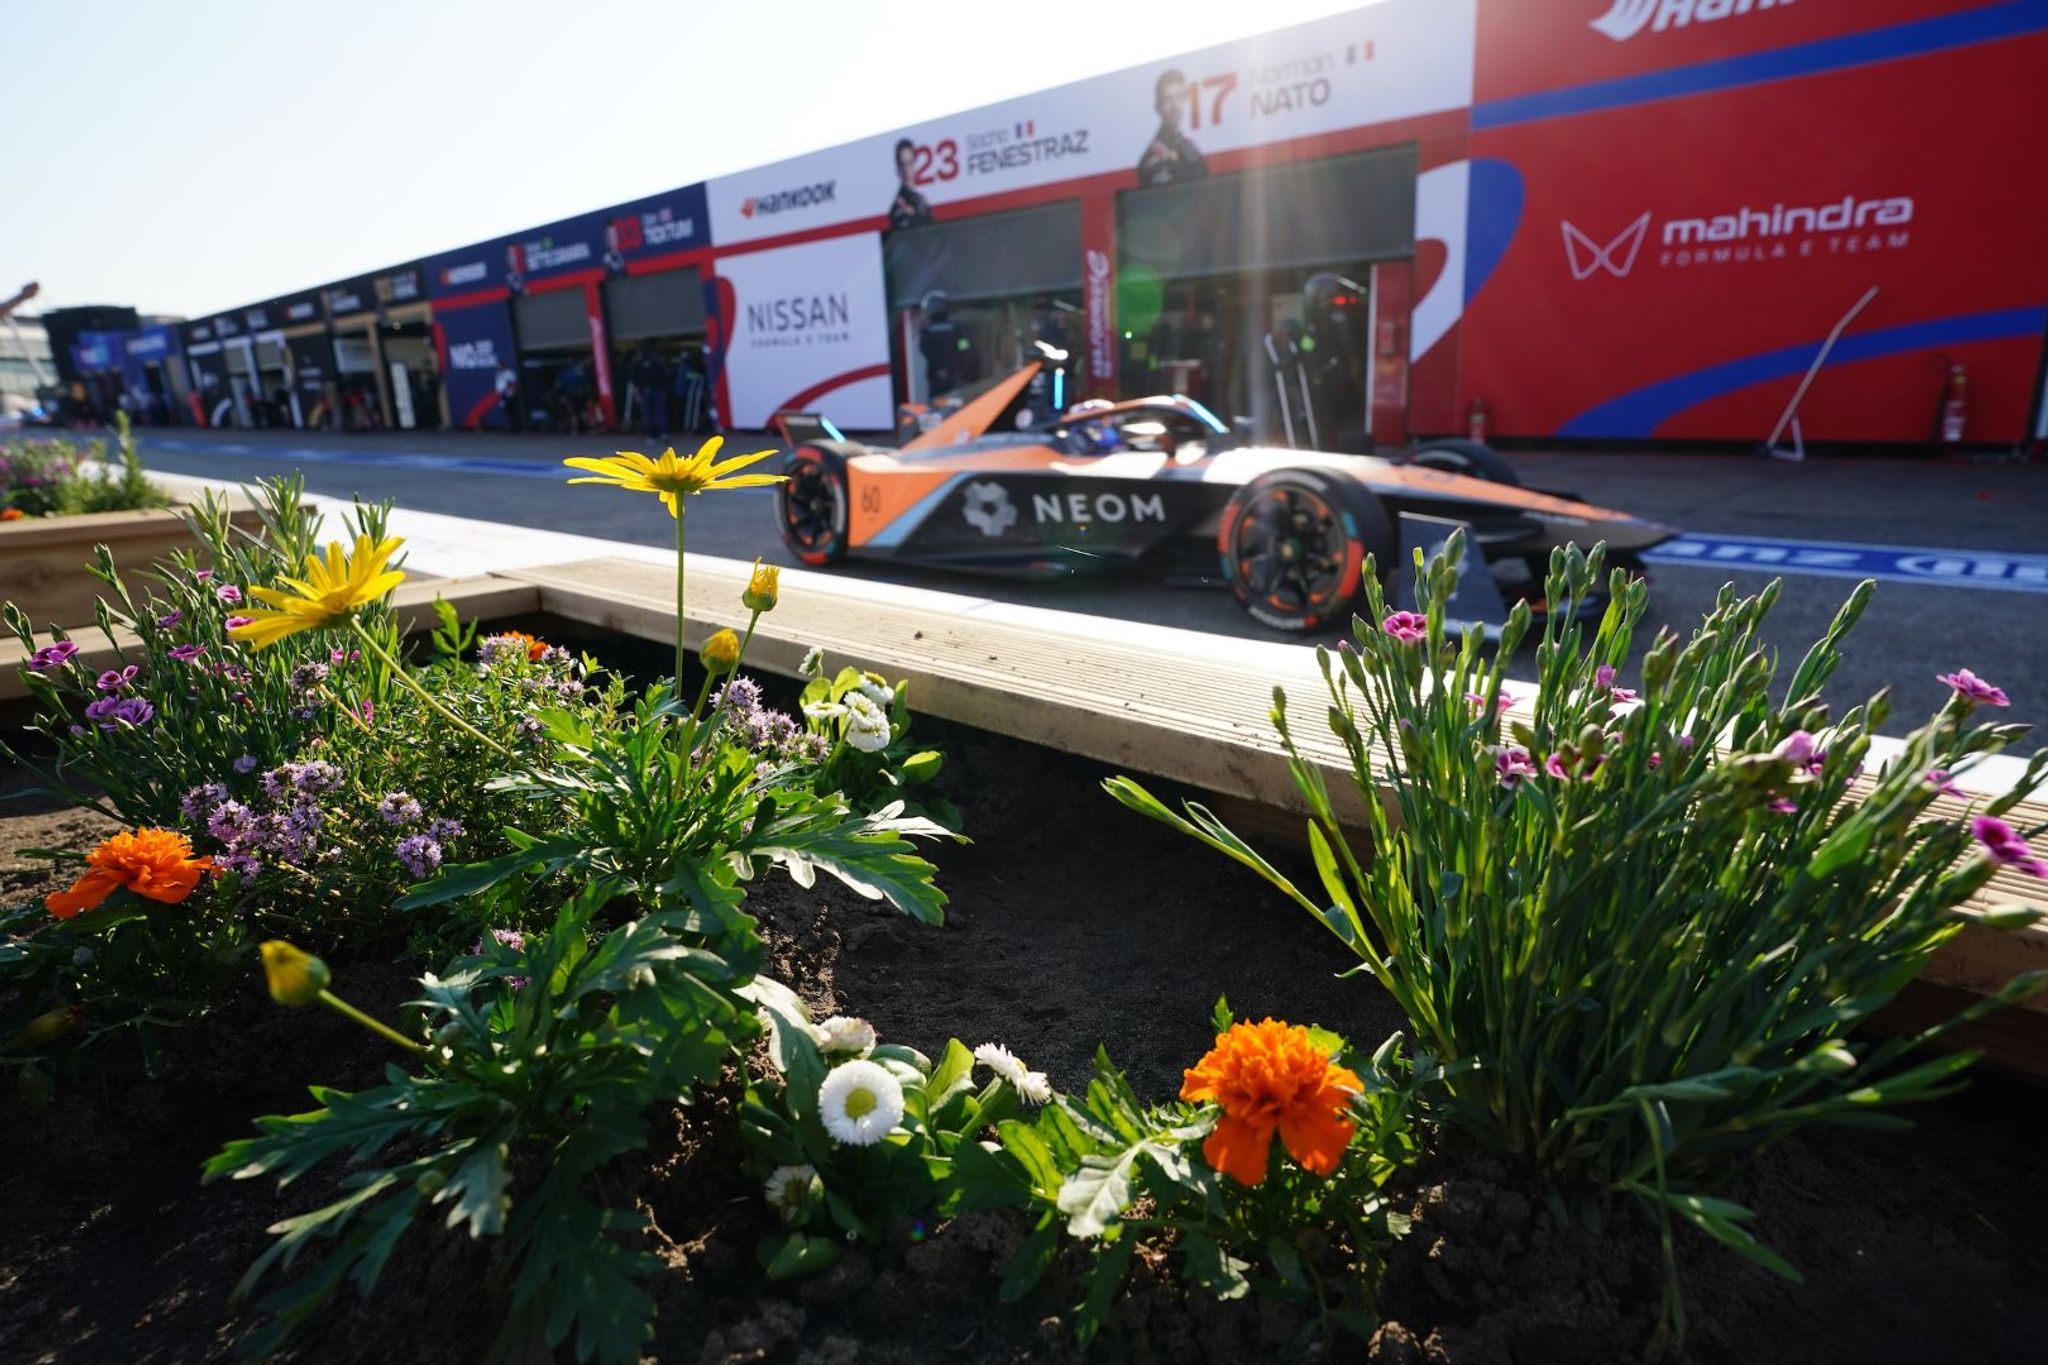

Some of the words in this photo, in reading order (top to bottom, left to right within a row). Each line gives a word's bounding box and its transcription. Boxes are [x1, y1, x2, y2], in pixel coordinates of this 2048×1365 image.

[1187, 72, 1238, 129] 17
[1250, 78, 1331, 119] NATO
[914, 137, 960, 186] 23
[966, 130, 1090, 178] FENESTRAZ
[1663, 196, 1915, 246] mahindra
[1659, 243, 1787, 268] FORMULA
[1799, 241, 1814, 257] E
[1829, 231, 1911, 255] TEAM
[747, 293, 848, 334] NISSAN
[1032, 493, 1165, 523] NEOM
